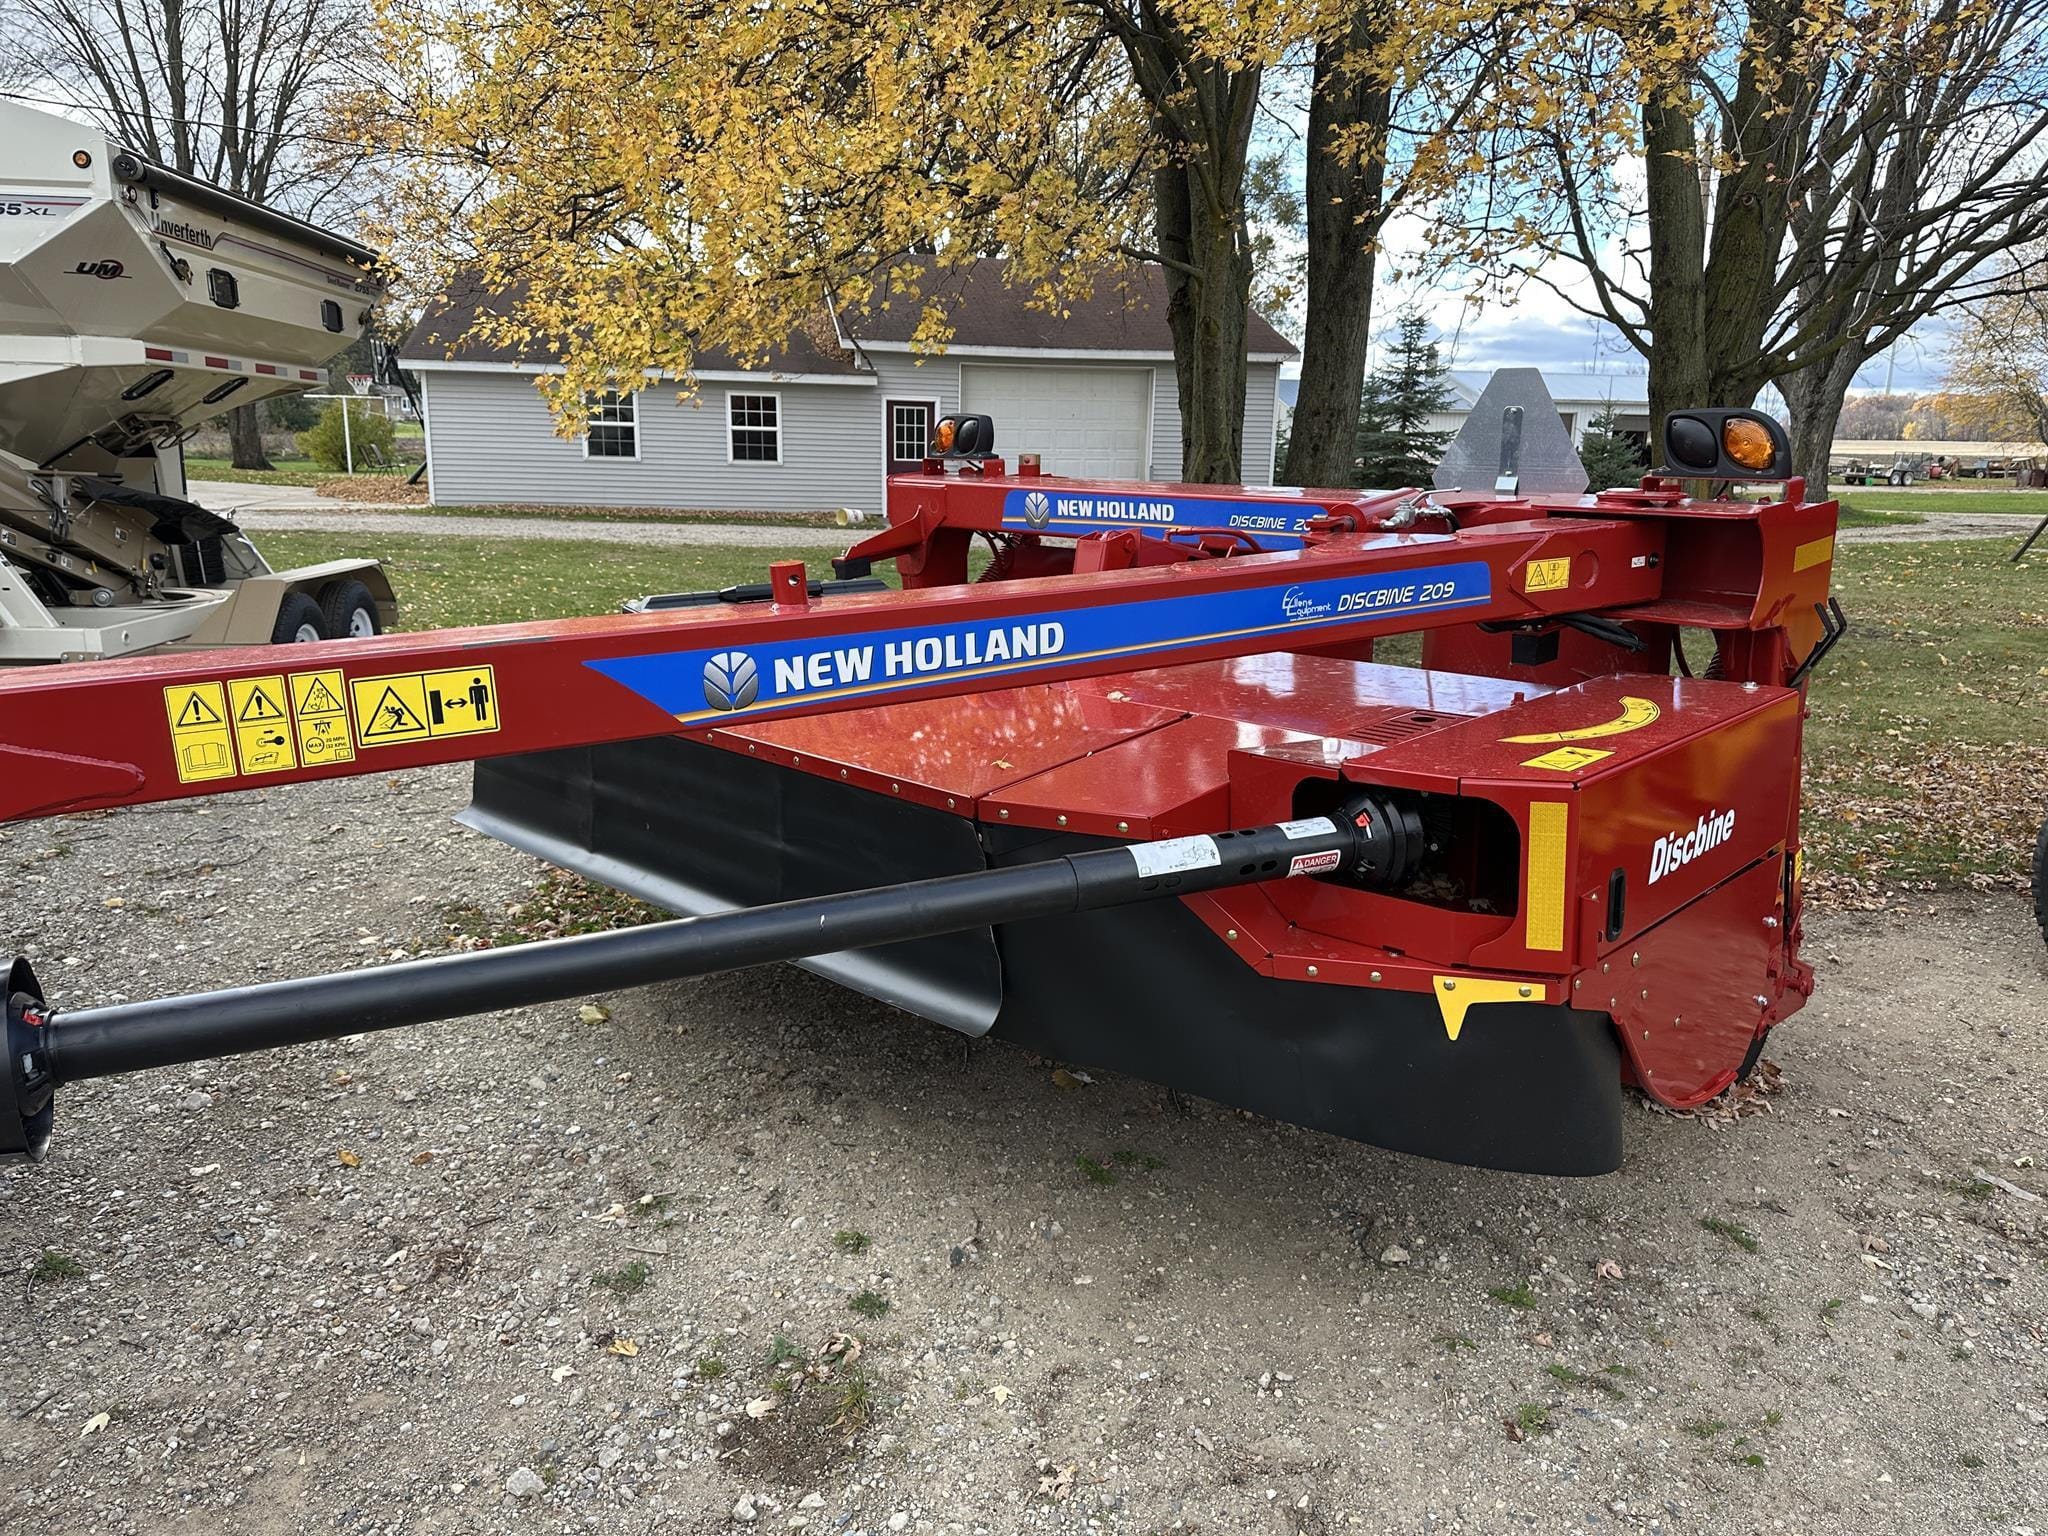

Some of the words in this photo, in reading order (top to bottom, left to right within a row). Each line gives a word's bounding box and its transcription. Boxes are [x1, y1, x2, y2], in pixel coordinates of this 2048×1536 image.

[24, 207, 57, 216] XL
[151, 209, 212, 248] Unverferth
[1057, 499, 1093, 517] NEW
[1096, 500, 1175, 522] HOLLAND
[1229, 514, 1287, 530] DISCBINE
[1287, 592, 1332, 617] Equipment
[1337, 585, 1416, 612] DISCBINE
[1419, 581, 1456, 602] 209
[774, 645, 874, 694] NEW
[885, 622, 1065, 677] HOLLAND
[1648, 808, 1735, 886] Discbine
[1304, 854, 1338, 868] DANGER
